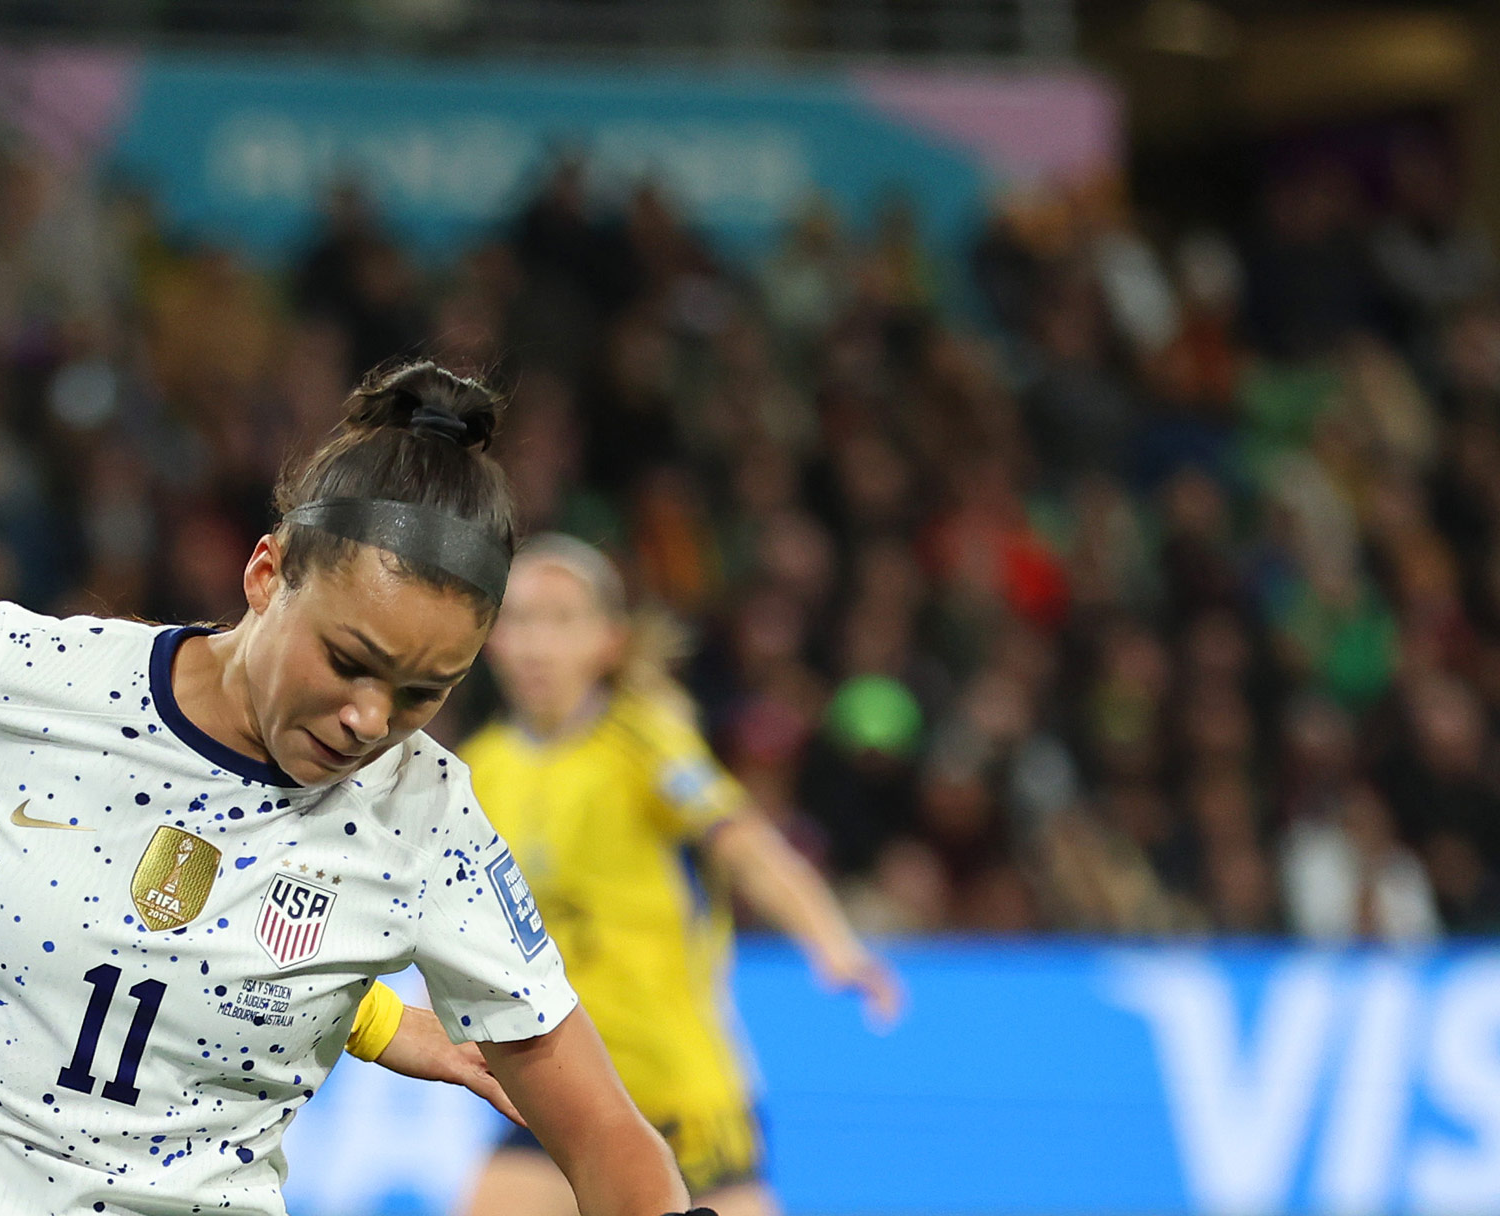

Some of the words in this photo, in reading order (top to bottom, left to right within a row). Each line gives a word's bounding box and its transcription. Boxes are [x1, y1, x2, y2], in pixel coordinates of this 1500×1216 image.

[146, 888, 181, 913] FIFA
[271, 879, 330, 920] USA
[147, 908, 169, 923] 2019
[242, 979, 257, 992] USA
[263, 982, 293, 1000] SWEDEN
[236, 992, 243, 1004] 6
[243, 994, 271, 1010] AUGUST
[271, 1000, 289, 1013] 2023
[56, 962, 168, 1107] 11
